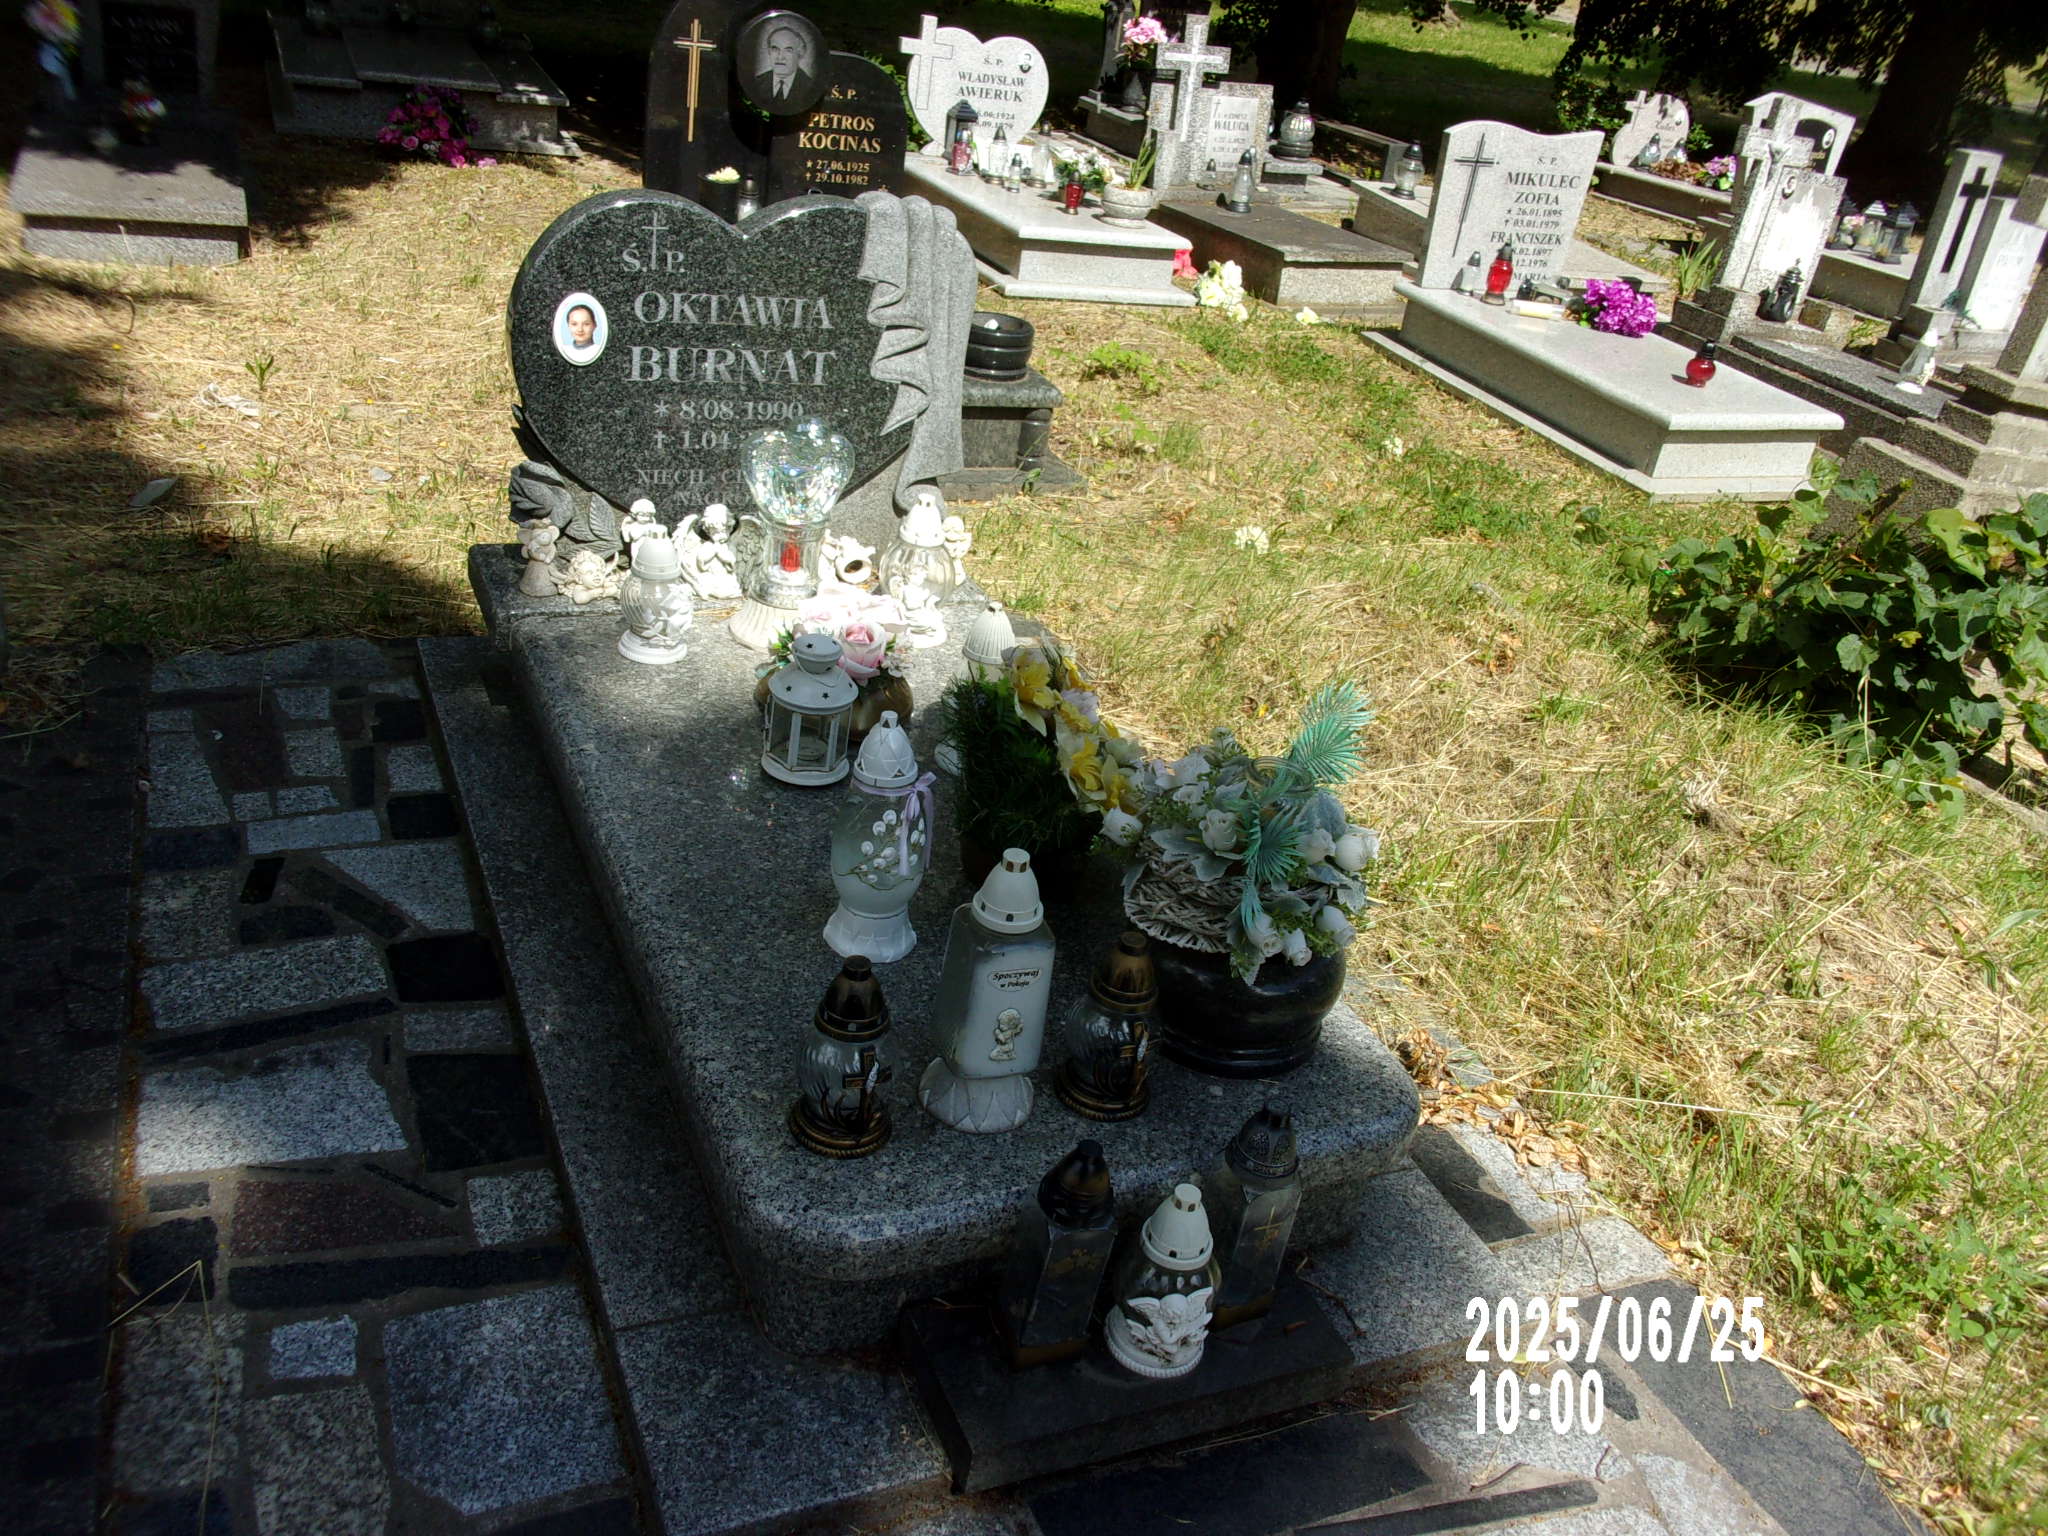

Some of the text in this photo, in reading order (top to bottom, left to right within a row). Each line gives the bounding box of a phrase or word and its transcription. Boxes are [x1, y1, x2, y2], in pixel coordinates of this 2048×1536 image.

[831, 84, 858, 100] Ś. P.
[956, 86, 1024, 103] AWIERUK
[808, 112, 875, 132] PETROS
[798, 131, 881, 153] KOCINAS
[816, 160, 870, 172] 27.06.1925
[815, 173, 869, 185] 29.10.1982
[1506, 171, 1581, 189] MIKULEC
[1514, 191, 1559, 205] ZOFIA
[1490, 231, 1563, 246] FRANCISZEK
[621, 242, 686, 273] Ś. P.
[633, 290, 835, 330] OKTAWIA
[624, 345, 838, 387] BURNAT
[679, 400, 803, 421] 8.08.1990
[636, 468, 704, 485] NIECH
